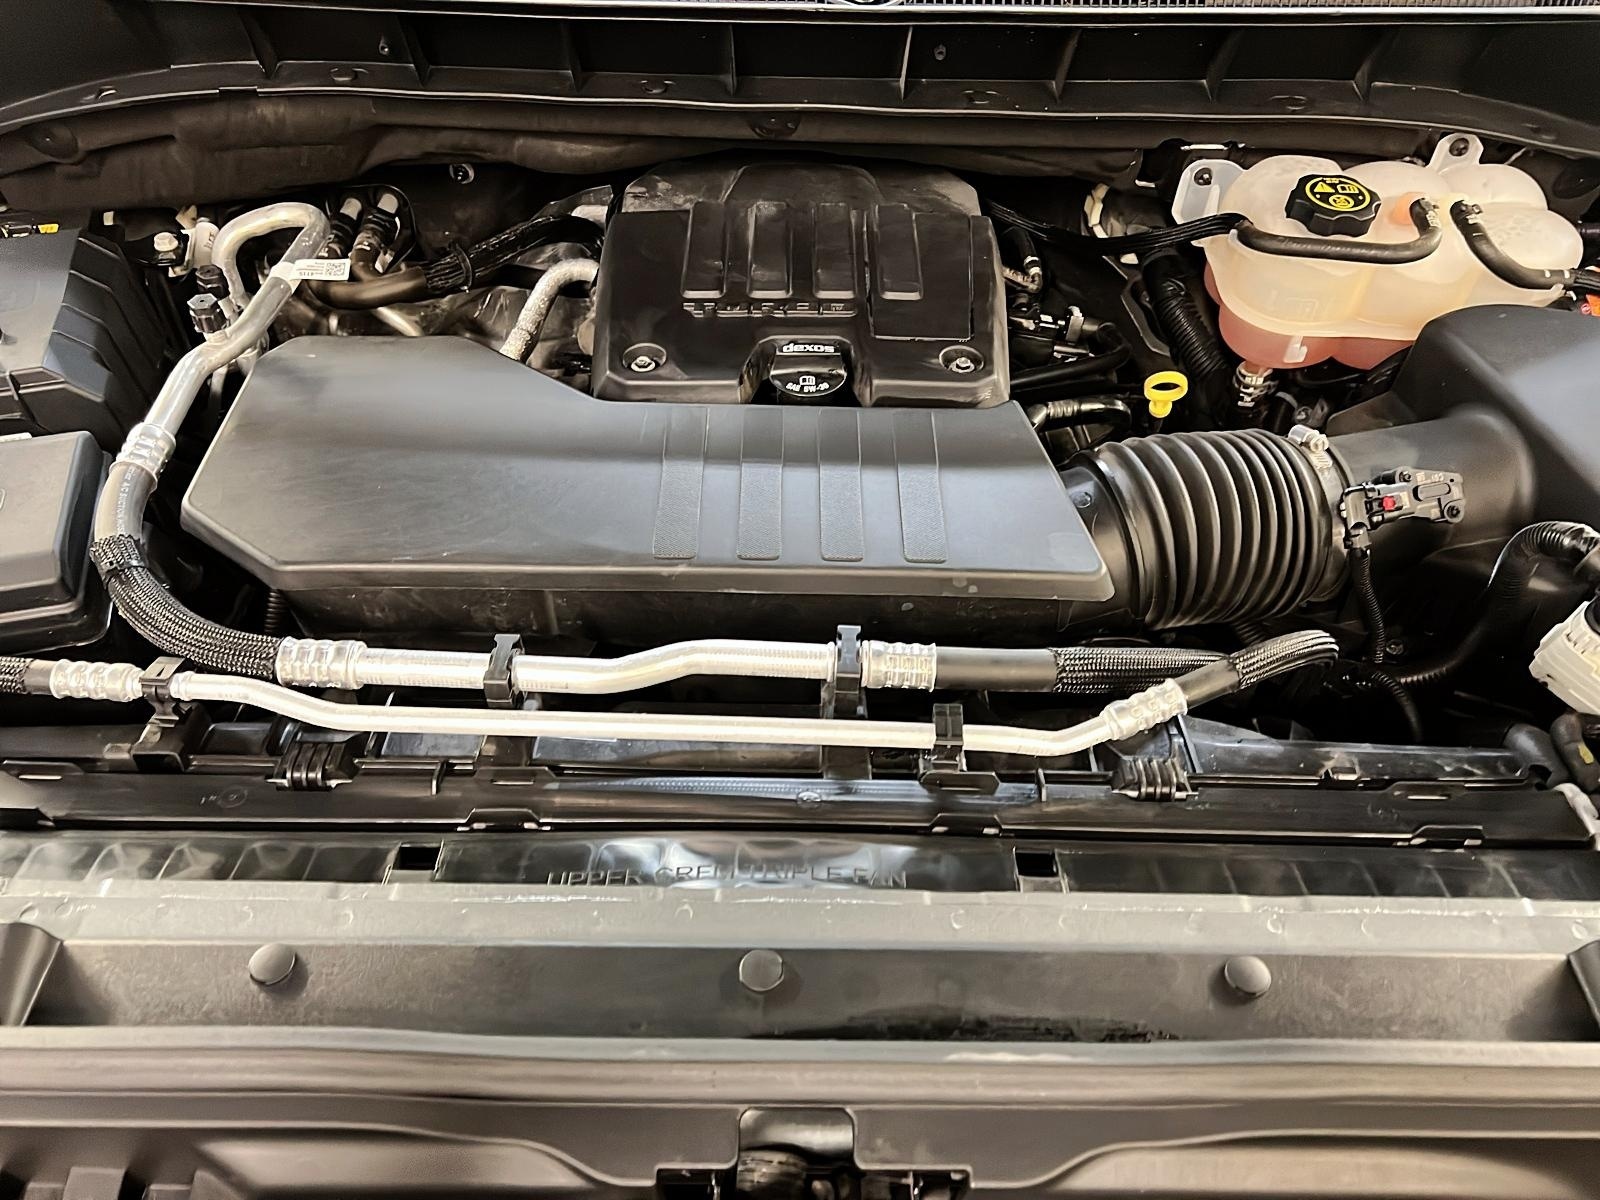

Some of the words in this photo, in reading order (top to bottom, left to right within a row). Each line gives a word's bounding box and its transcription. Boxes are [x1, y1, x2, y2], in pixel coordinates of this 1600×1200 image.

[782, 342, 835, 353] dexos
[547, 868, 643, 886] UPPER
[853, 868, 907, 889] FAN
